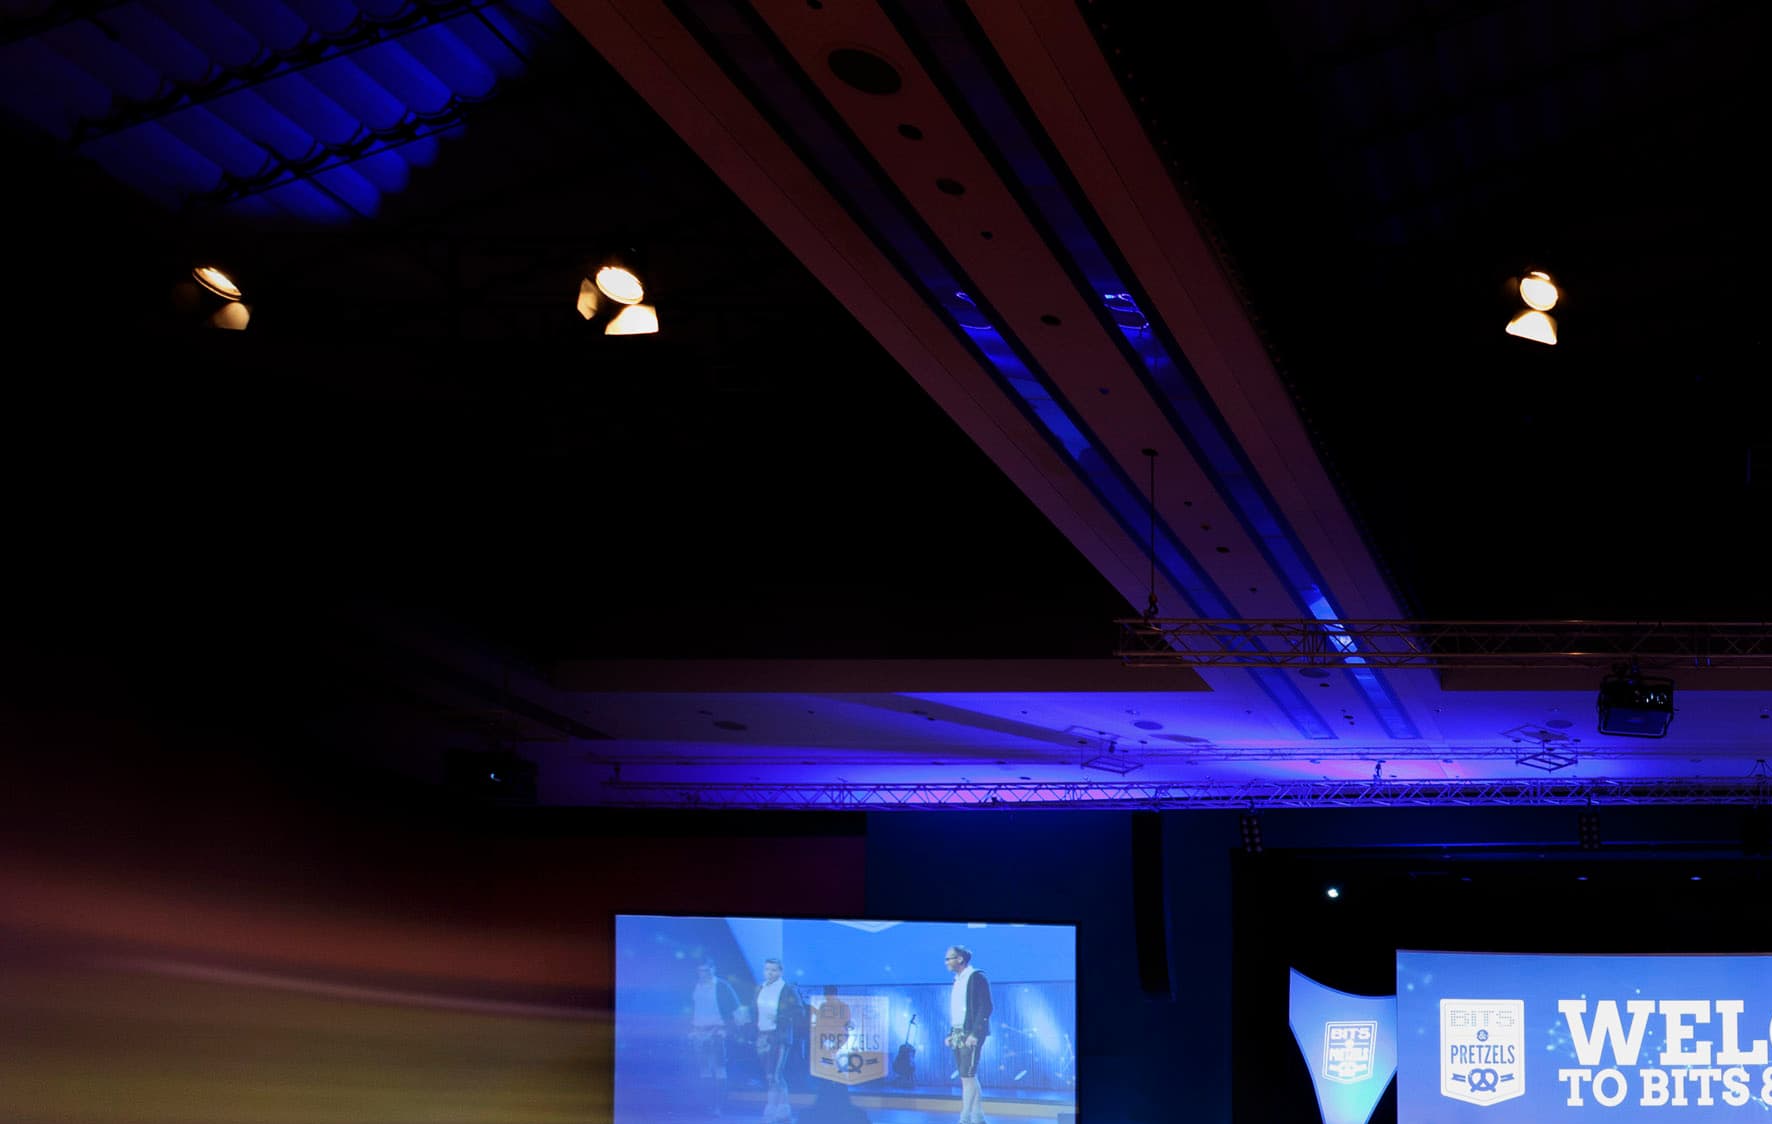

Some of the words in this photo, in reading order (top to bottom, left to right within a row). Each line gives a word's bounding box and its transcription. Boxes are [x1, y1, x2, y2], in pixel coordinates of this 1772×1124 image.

[1449, 1009, 1516, 1028] BITS
[1330, 1027, 1371, 1040] BITS
[1450, 1044, 1516, 1065] PRETZELS
[1558, 1068, 1628, 1107] TO
[1639, 1066, 1751, 1107] BITS
